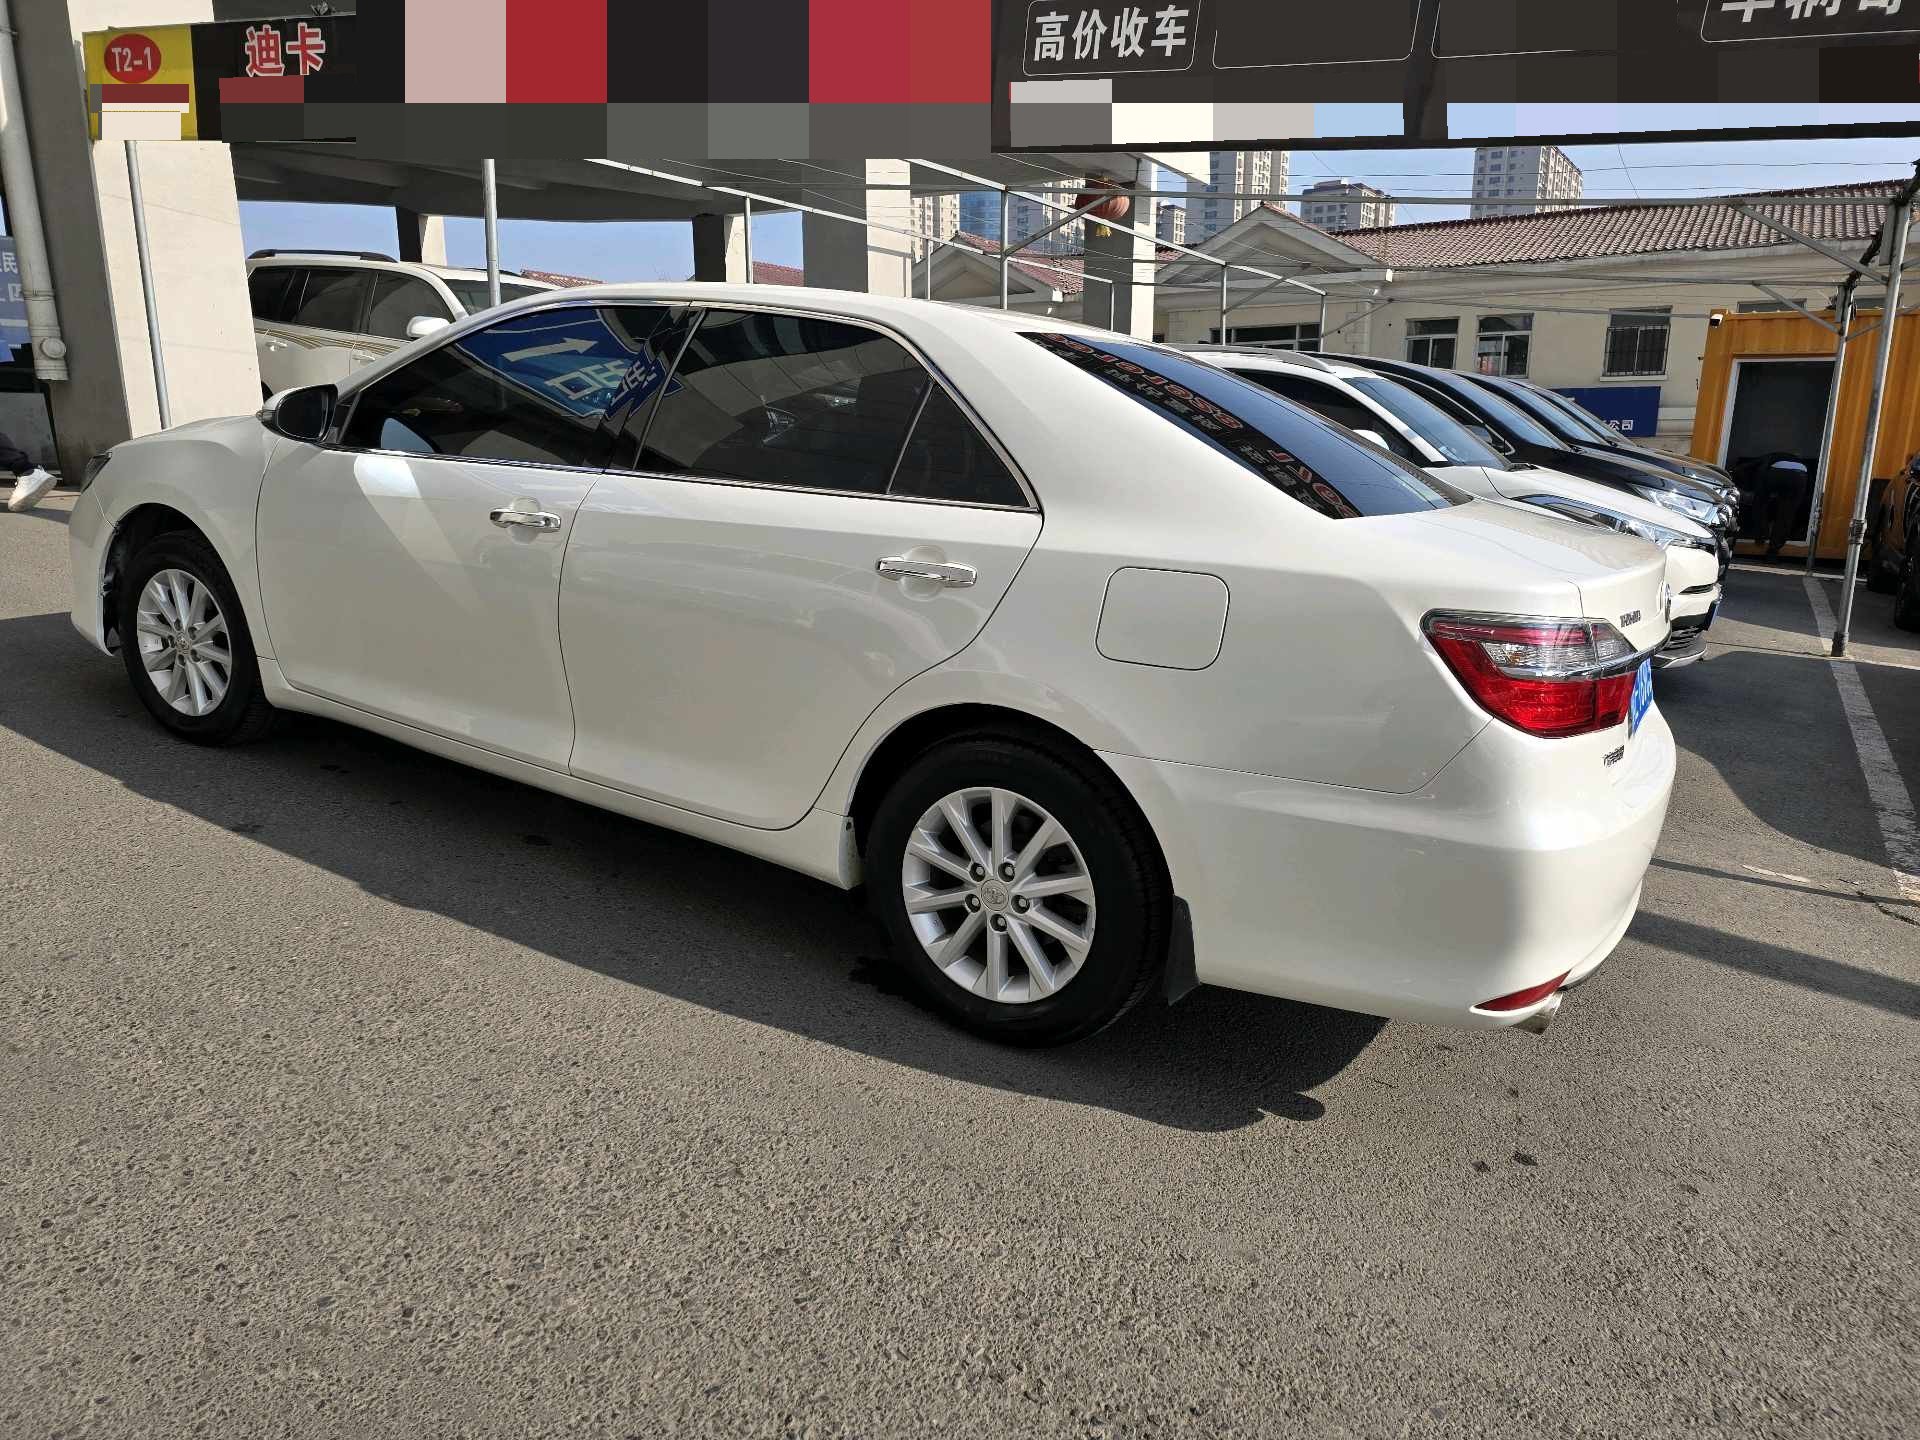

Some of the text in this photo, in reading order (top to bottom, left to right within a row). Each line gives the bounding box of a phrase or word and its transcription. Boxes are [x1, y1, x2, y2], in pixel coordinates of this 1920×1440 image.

[1034, 4, 1189, 62] 高价收车
[111, 46, 153, 73] T2-1
[245, 22, 326, 77] 迪卡
[0, 251, 18, 274] 民
[1602, 419, 1634, 431] 公司
